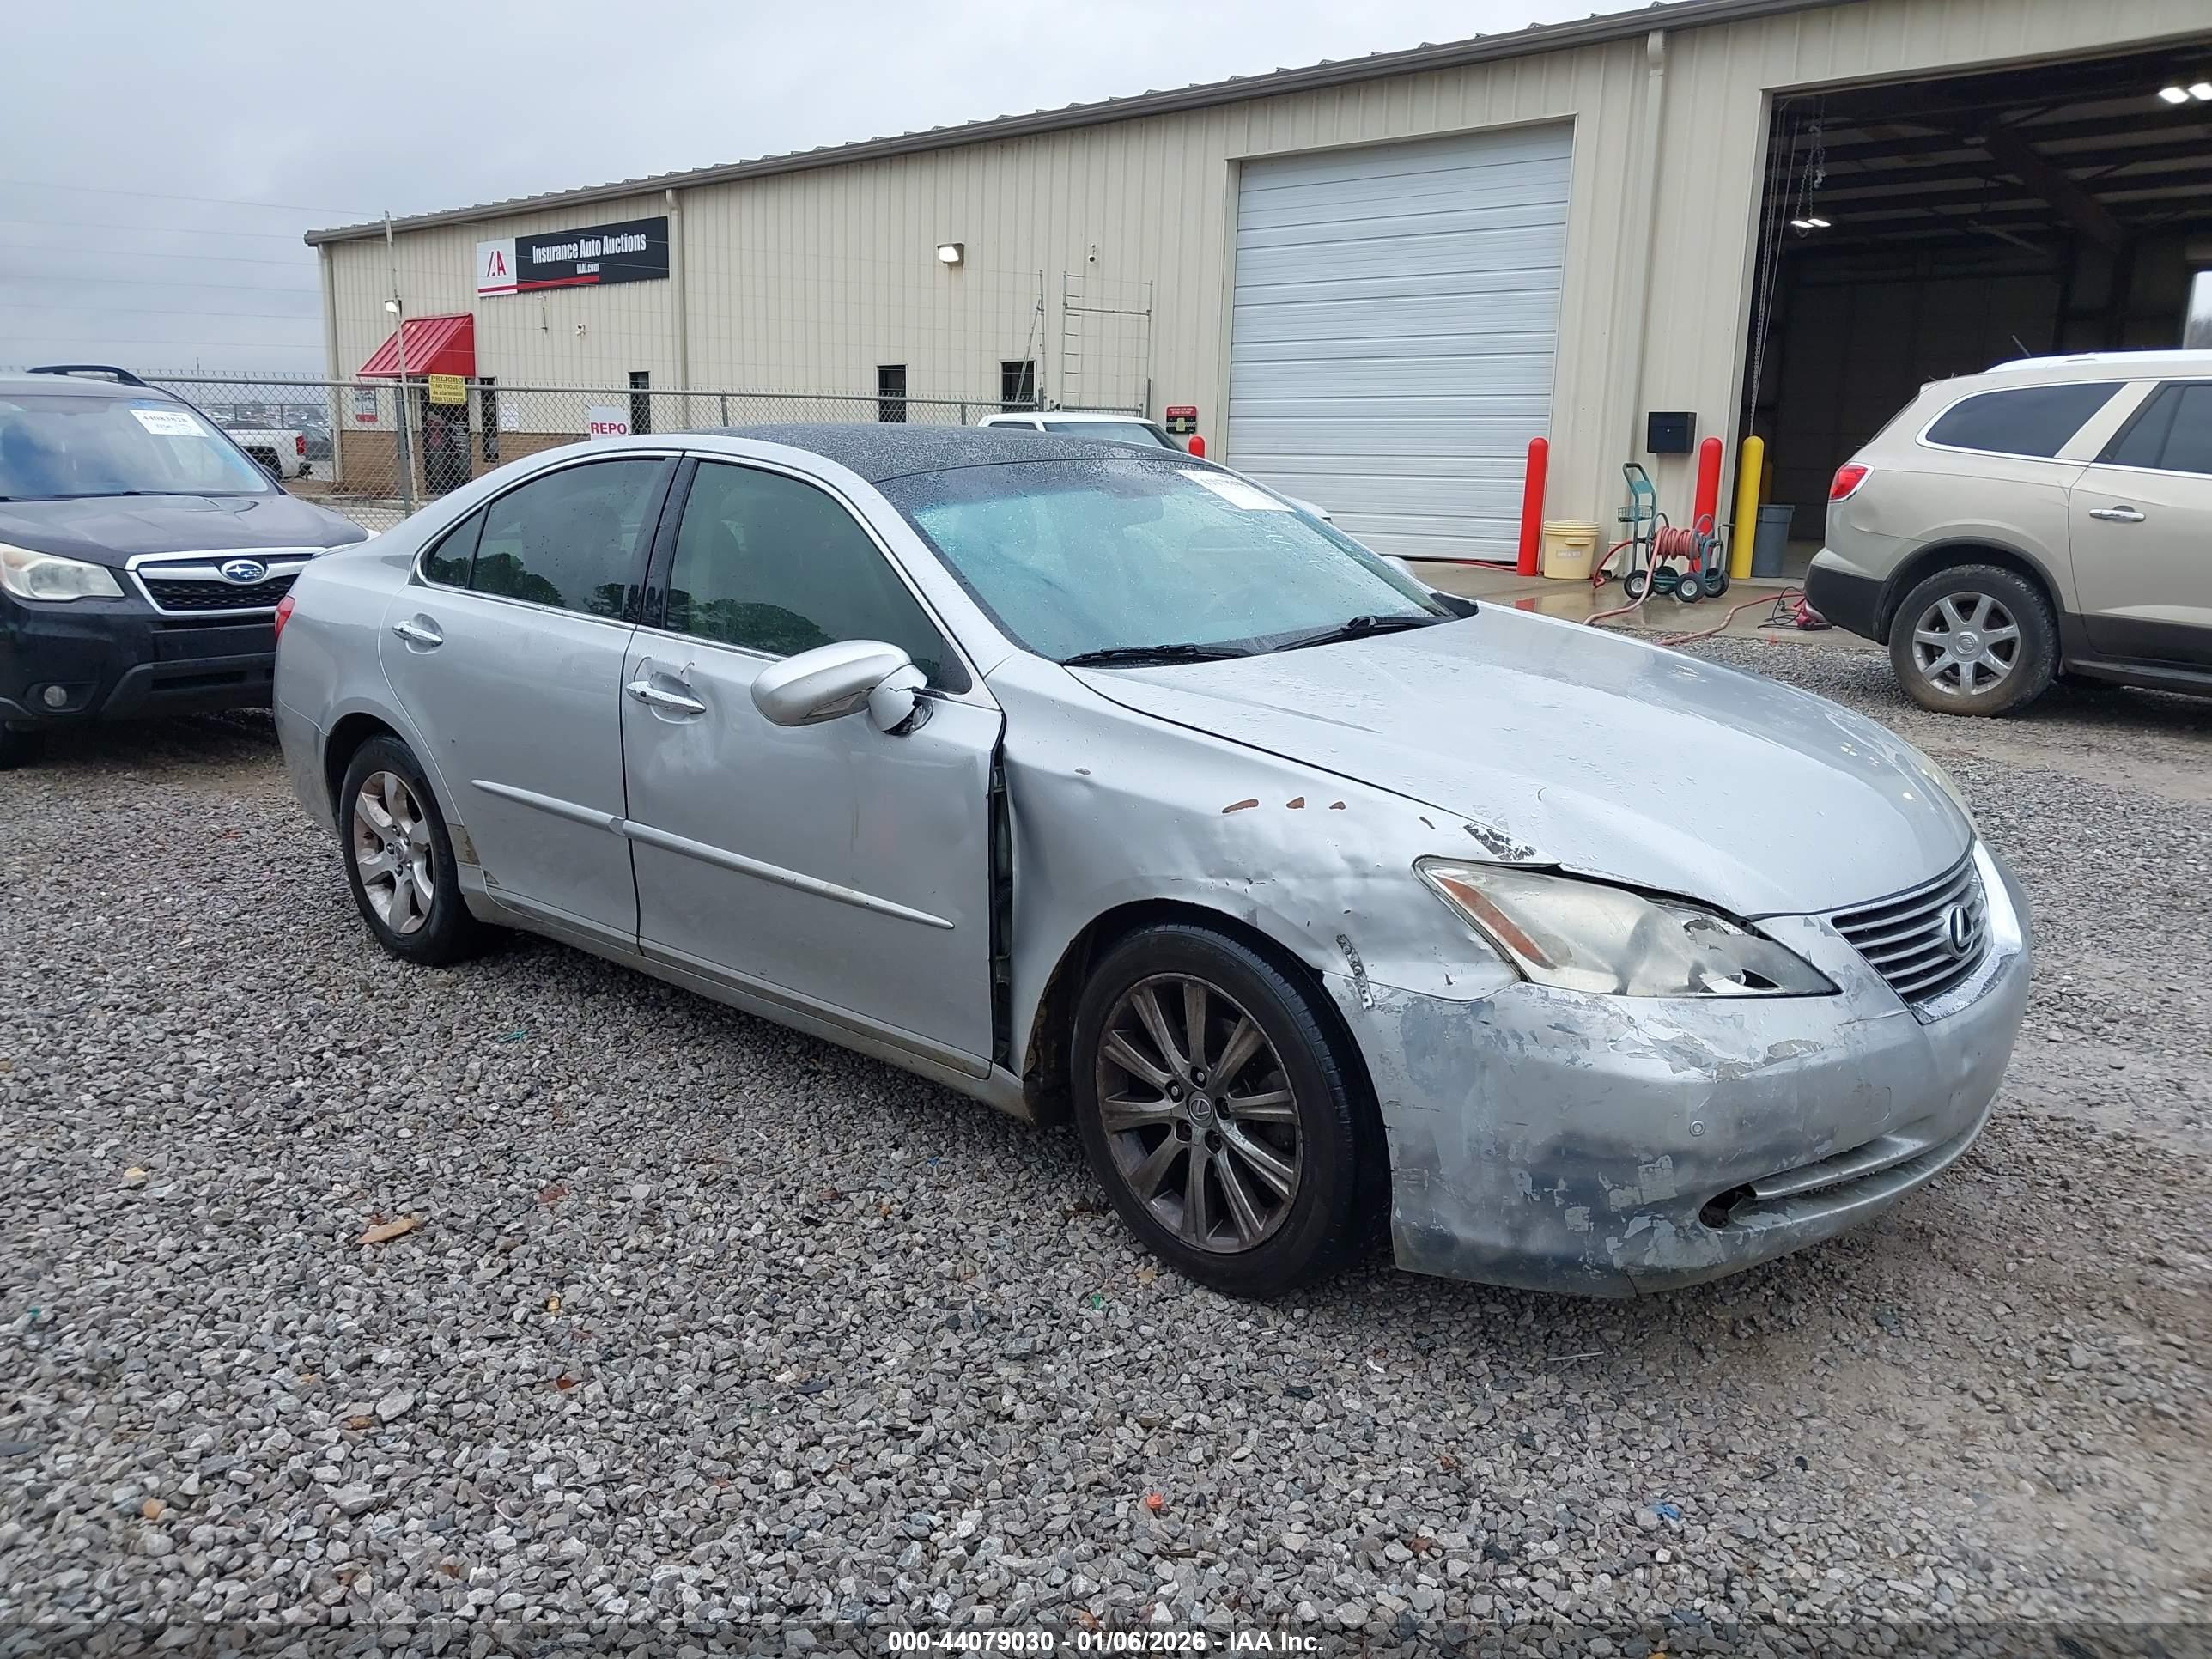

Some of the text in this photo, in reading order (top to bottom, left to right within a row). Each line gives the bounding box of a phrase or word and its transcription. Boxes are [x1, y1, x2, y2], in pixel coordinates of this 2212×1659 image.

[532, 232, 647, 264] Insurance Auto Auctions
[590, 422, 627, 434] REPO
